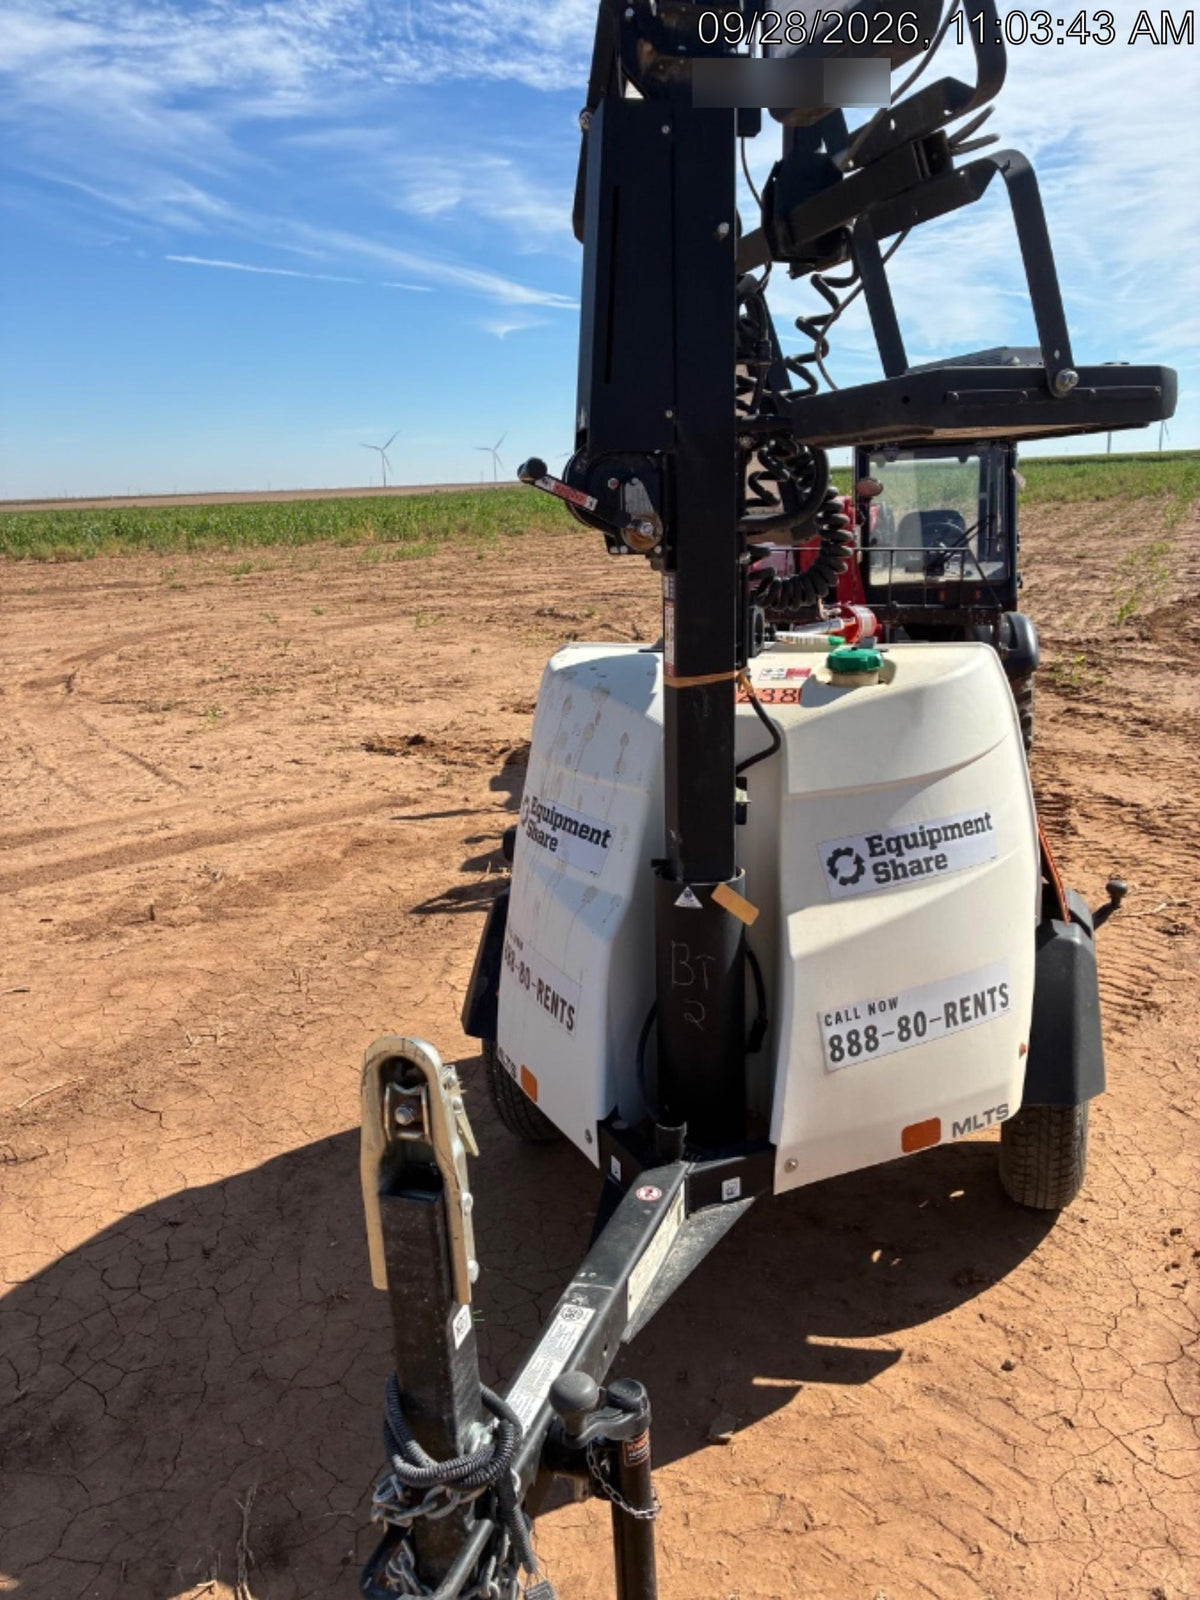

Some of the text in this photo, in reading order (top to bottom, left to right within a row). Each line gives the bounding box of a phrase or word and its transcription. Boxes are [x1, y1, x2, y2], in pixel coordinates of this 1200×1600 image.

[526, 819, 559, 852] Share
[531, 796, 612, 849] Equipment
[865, 812, 993, 857] Equipment
[872, 853, 948, 884] Share
[824, 996, 899, 1027] CALL NOW
[829, 983, 1010, 1063] 888-80-RENTS
[952, 1103, 1010, 1138] MLTS
